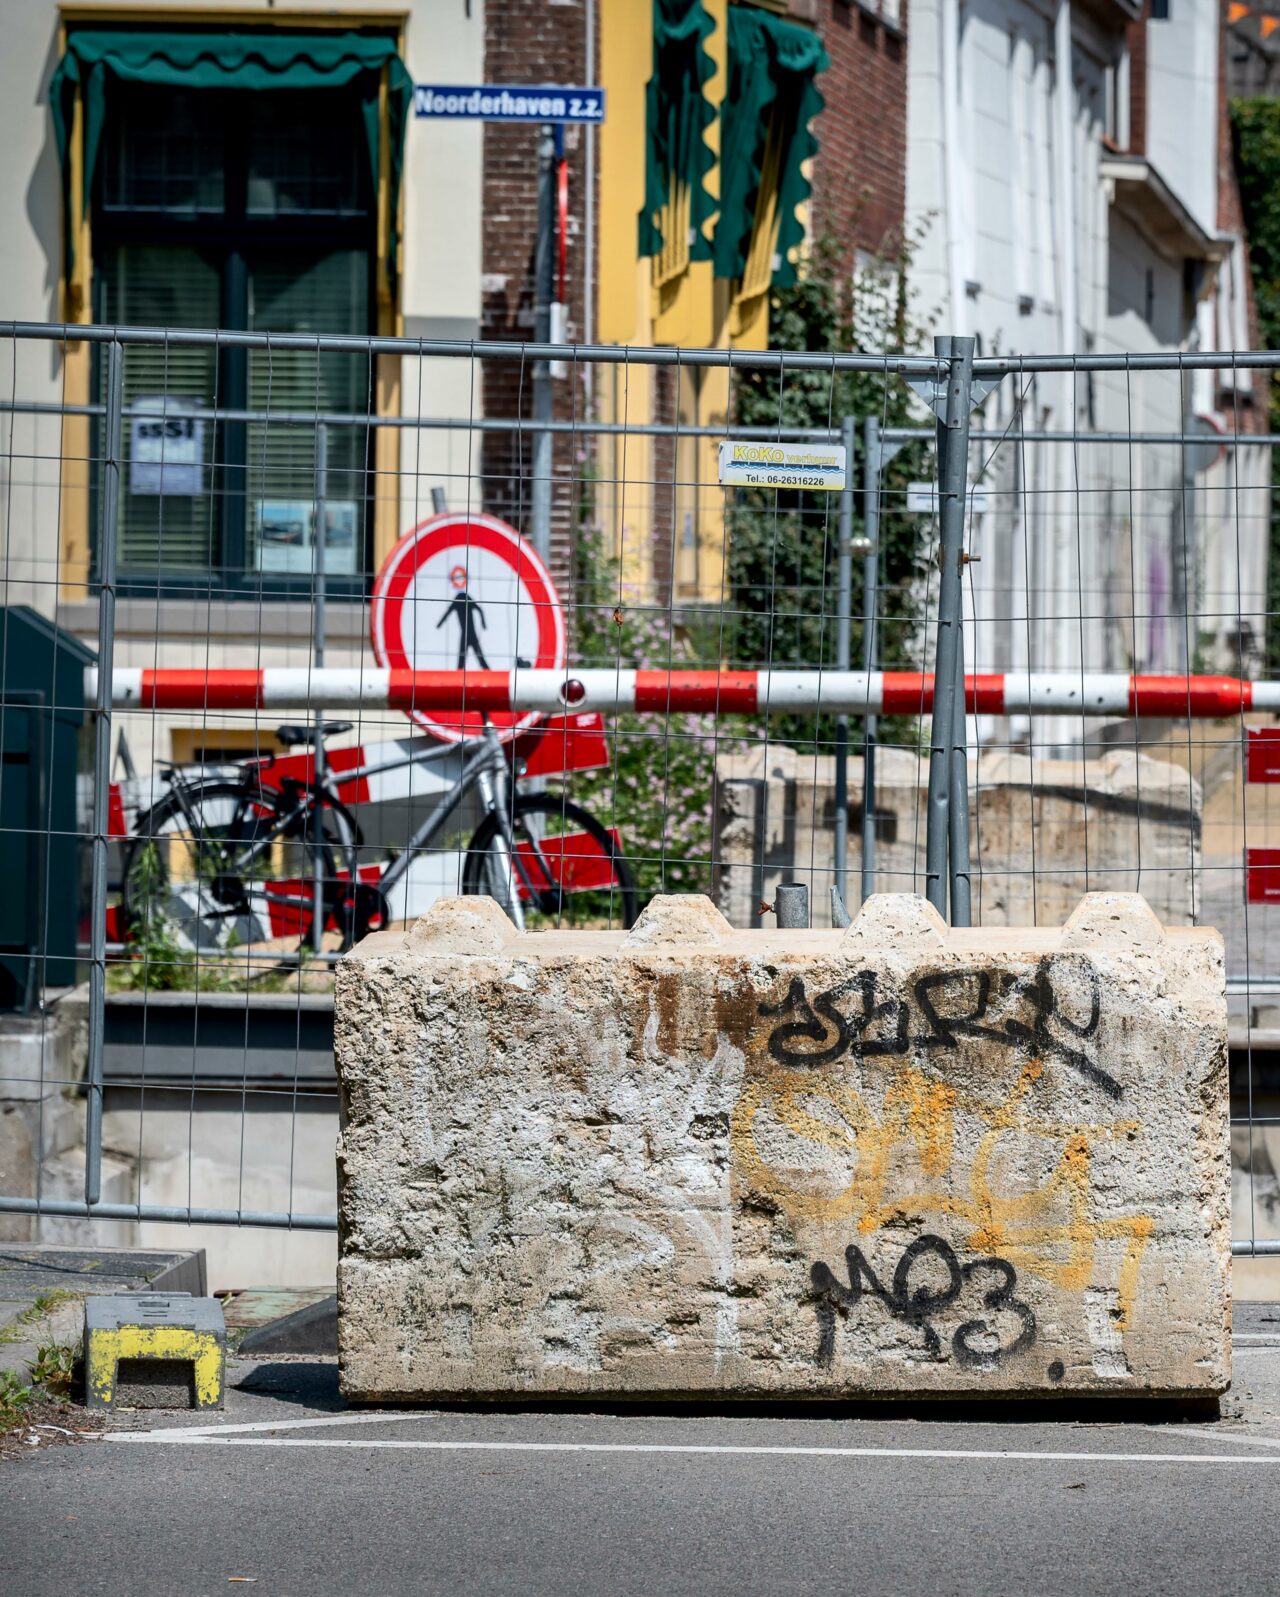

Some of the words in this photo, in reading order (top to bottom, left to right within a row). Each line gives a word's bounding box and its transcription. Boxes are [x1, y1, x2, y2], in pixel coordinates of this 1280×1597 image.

[415, 89, 566, 117] Noorderhaven
[568, 98, 604, 118] z.z.
[733, 445, 785, 462] KoKo
[746, 474, 765, 484] Tel.:
[767, 475, 825, 487] 06-26316226
